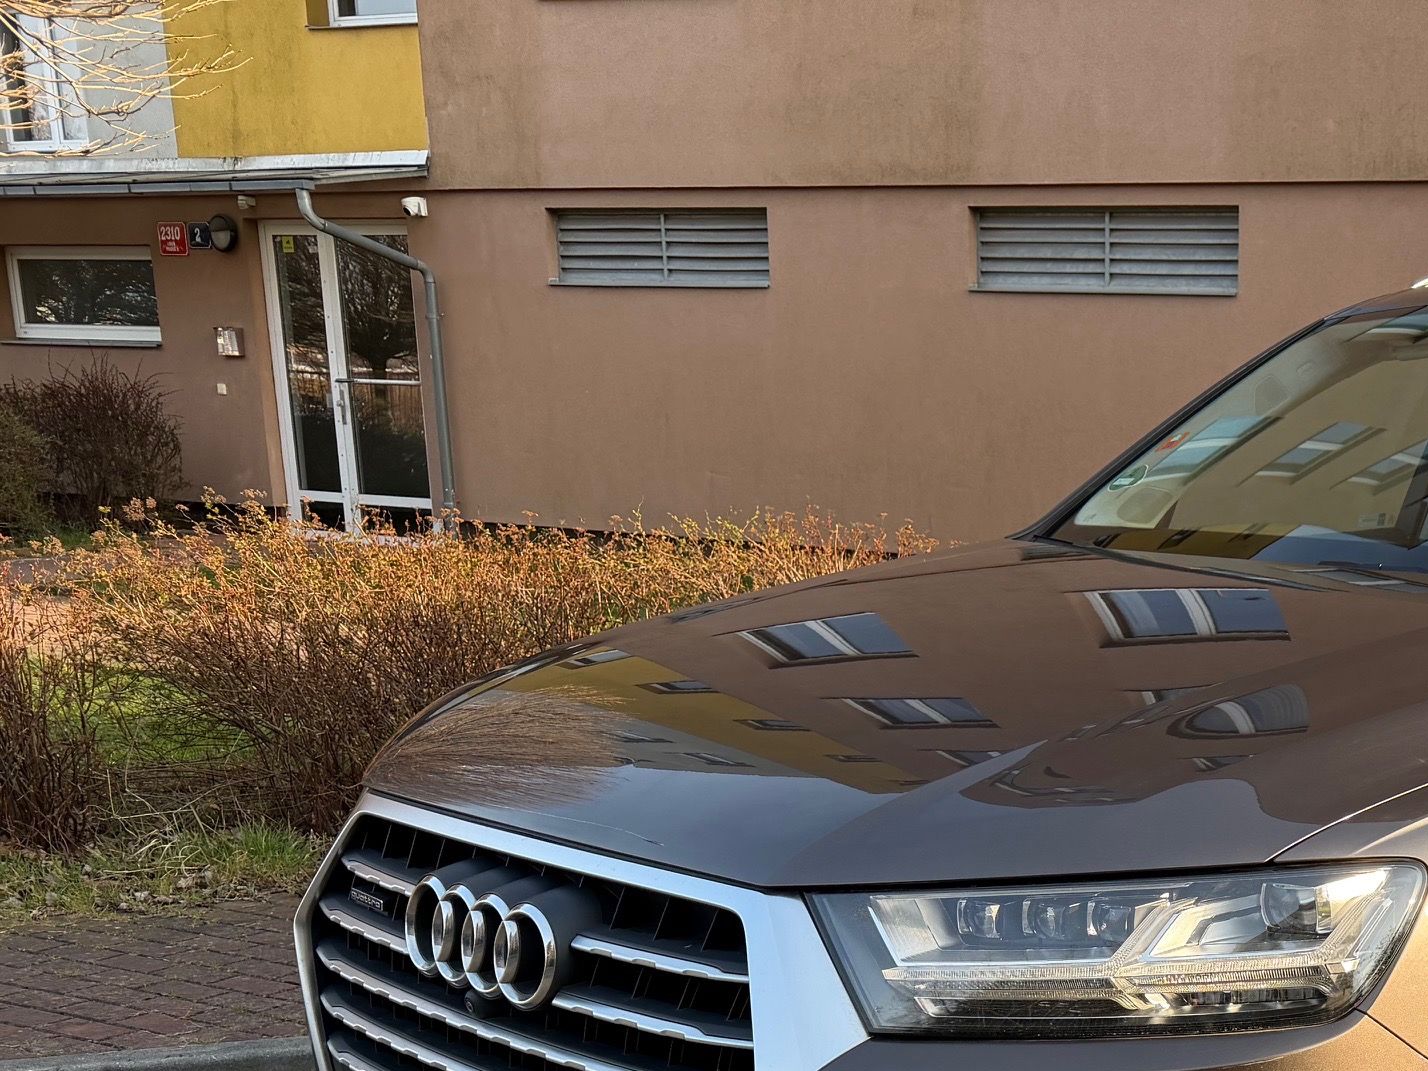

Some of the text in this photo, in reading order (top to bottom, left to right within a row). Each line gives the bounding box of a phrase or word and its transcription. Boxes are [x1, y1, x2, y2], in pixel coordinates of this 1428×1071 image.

[160, 226, 181, 240] 2310
[194, 227, 202, 242] 2
[351, 890, 381, 909] quattro
